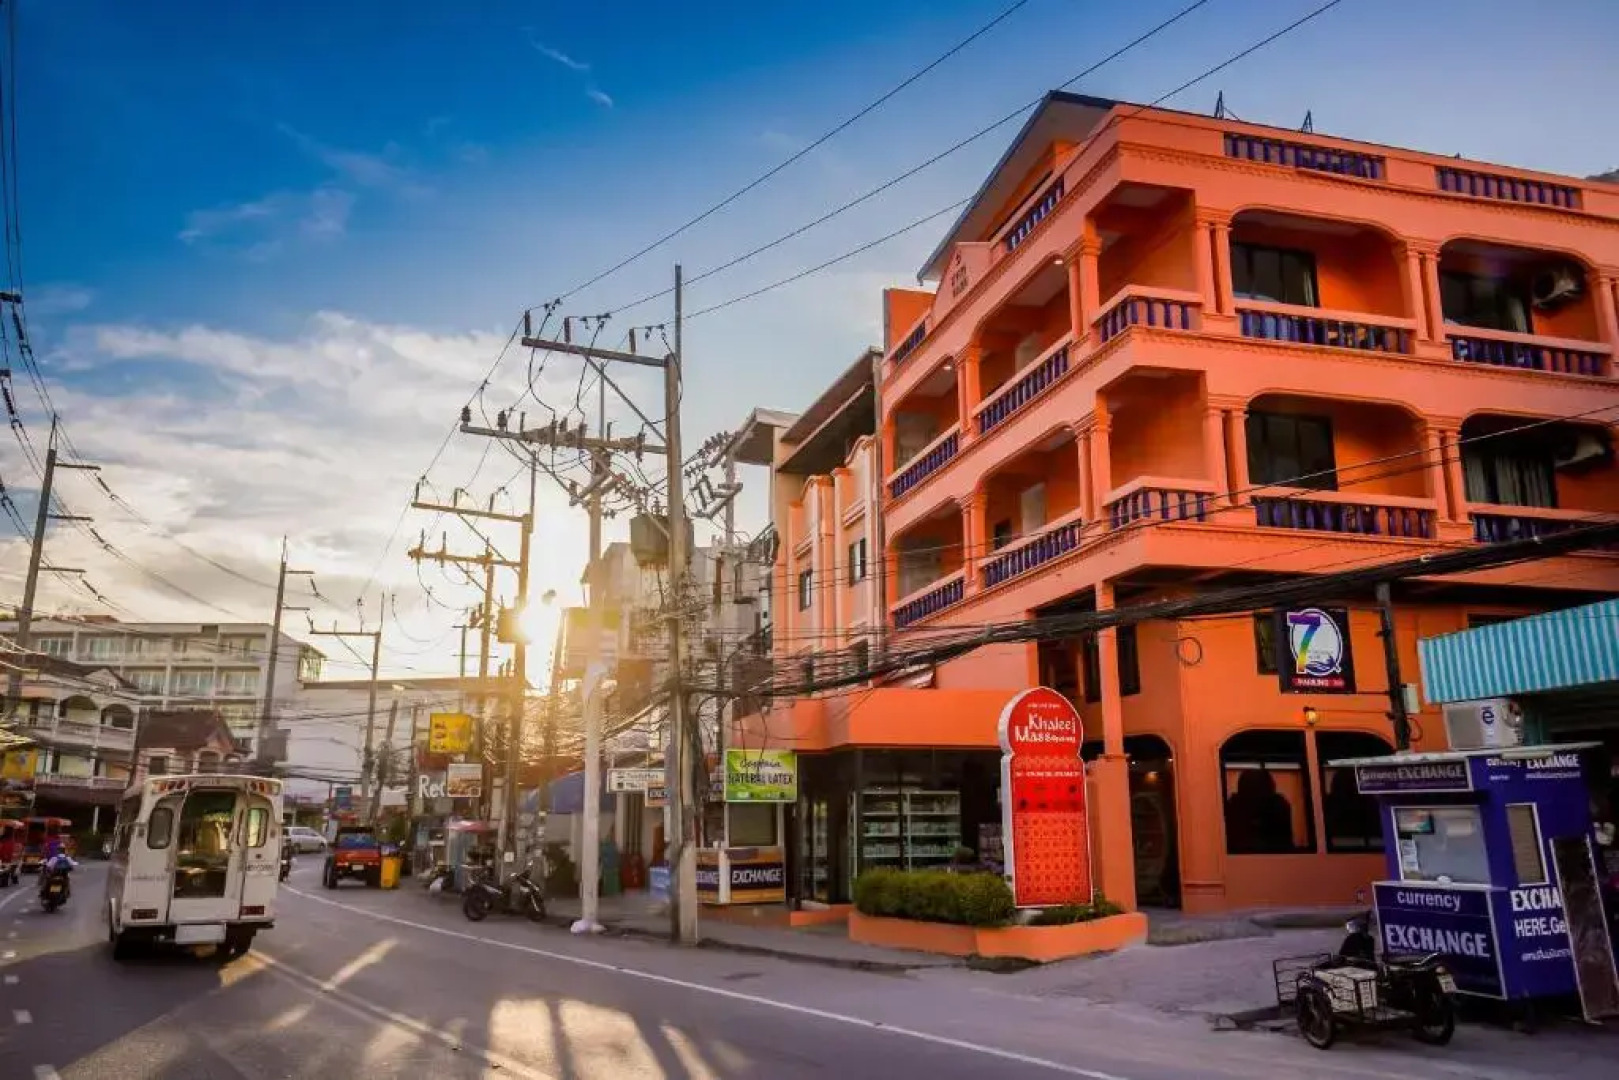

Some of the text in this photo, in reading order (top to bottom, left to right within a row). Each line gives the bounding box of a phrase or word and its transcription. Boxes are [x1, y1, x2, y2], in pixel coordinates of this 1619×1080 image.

[1397, 764, 1466, 779] EXCHANGE
[731, 869, 783, 884] EXCHANGE
[1396, 891, 1461, 912] currency
[1384, 923, 1490, 958] EXCHANGE
